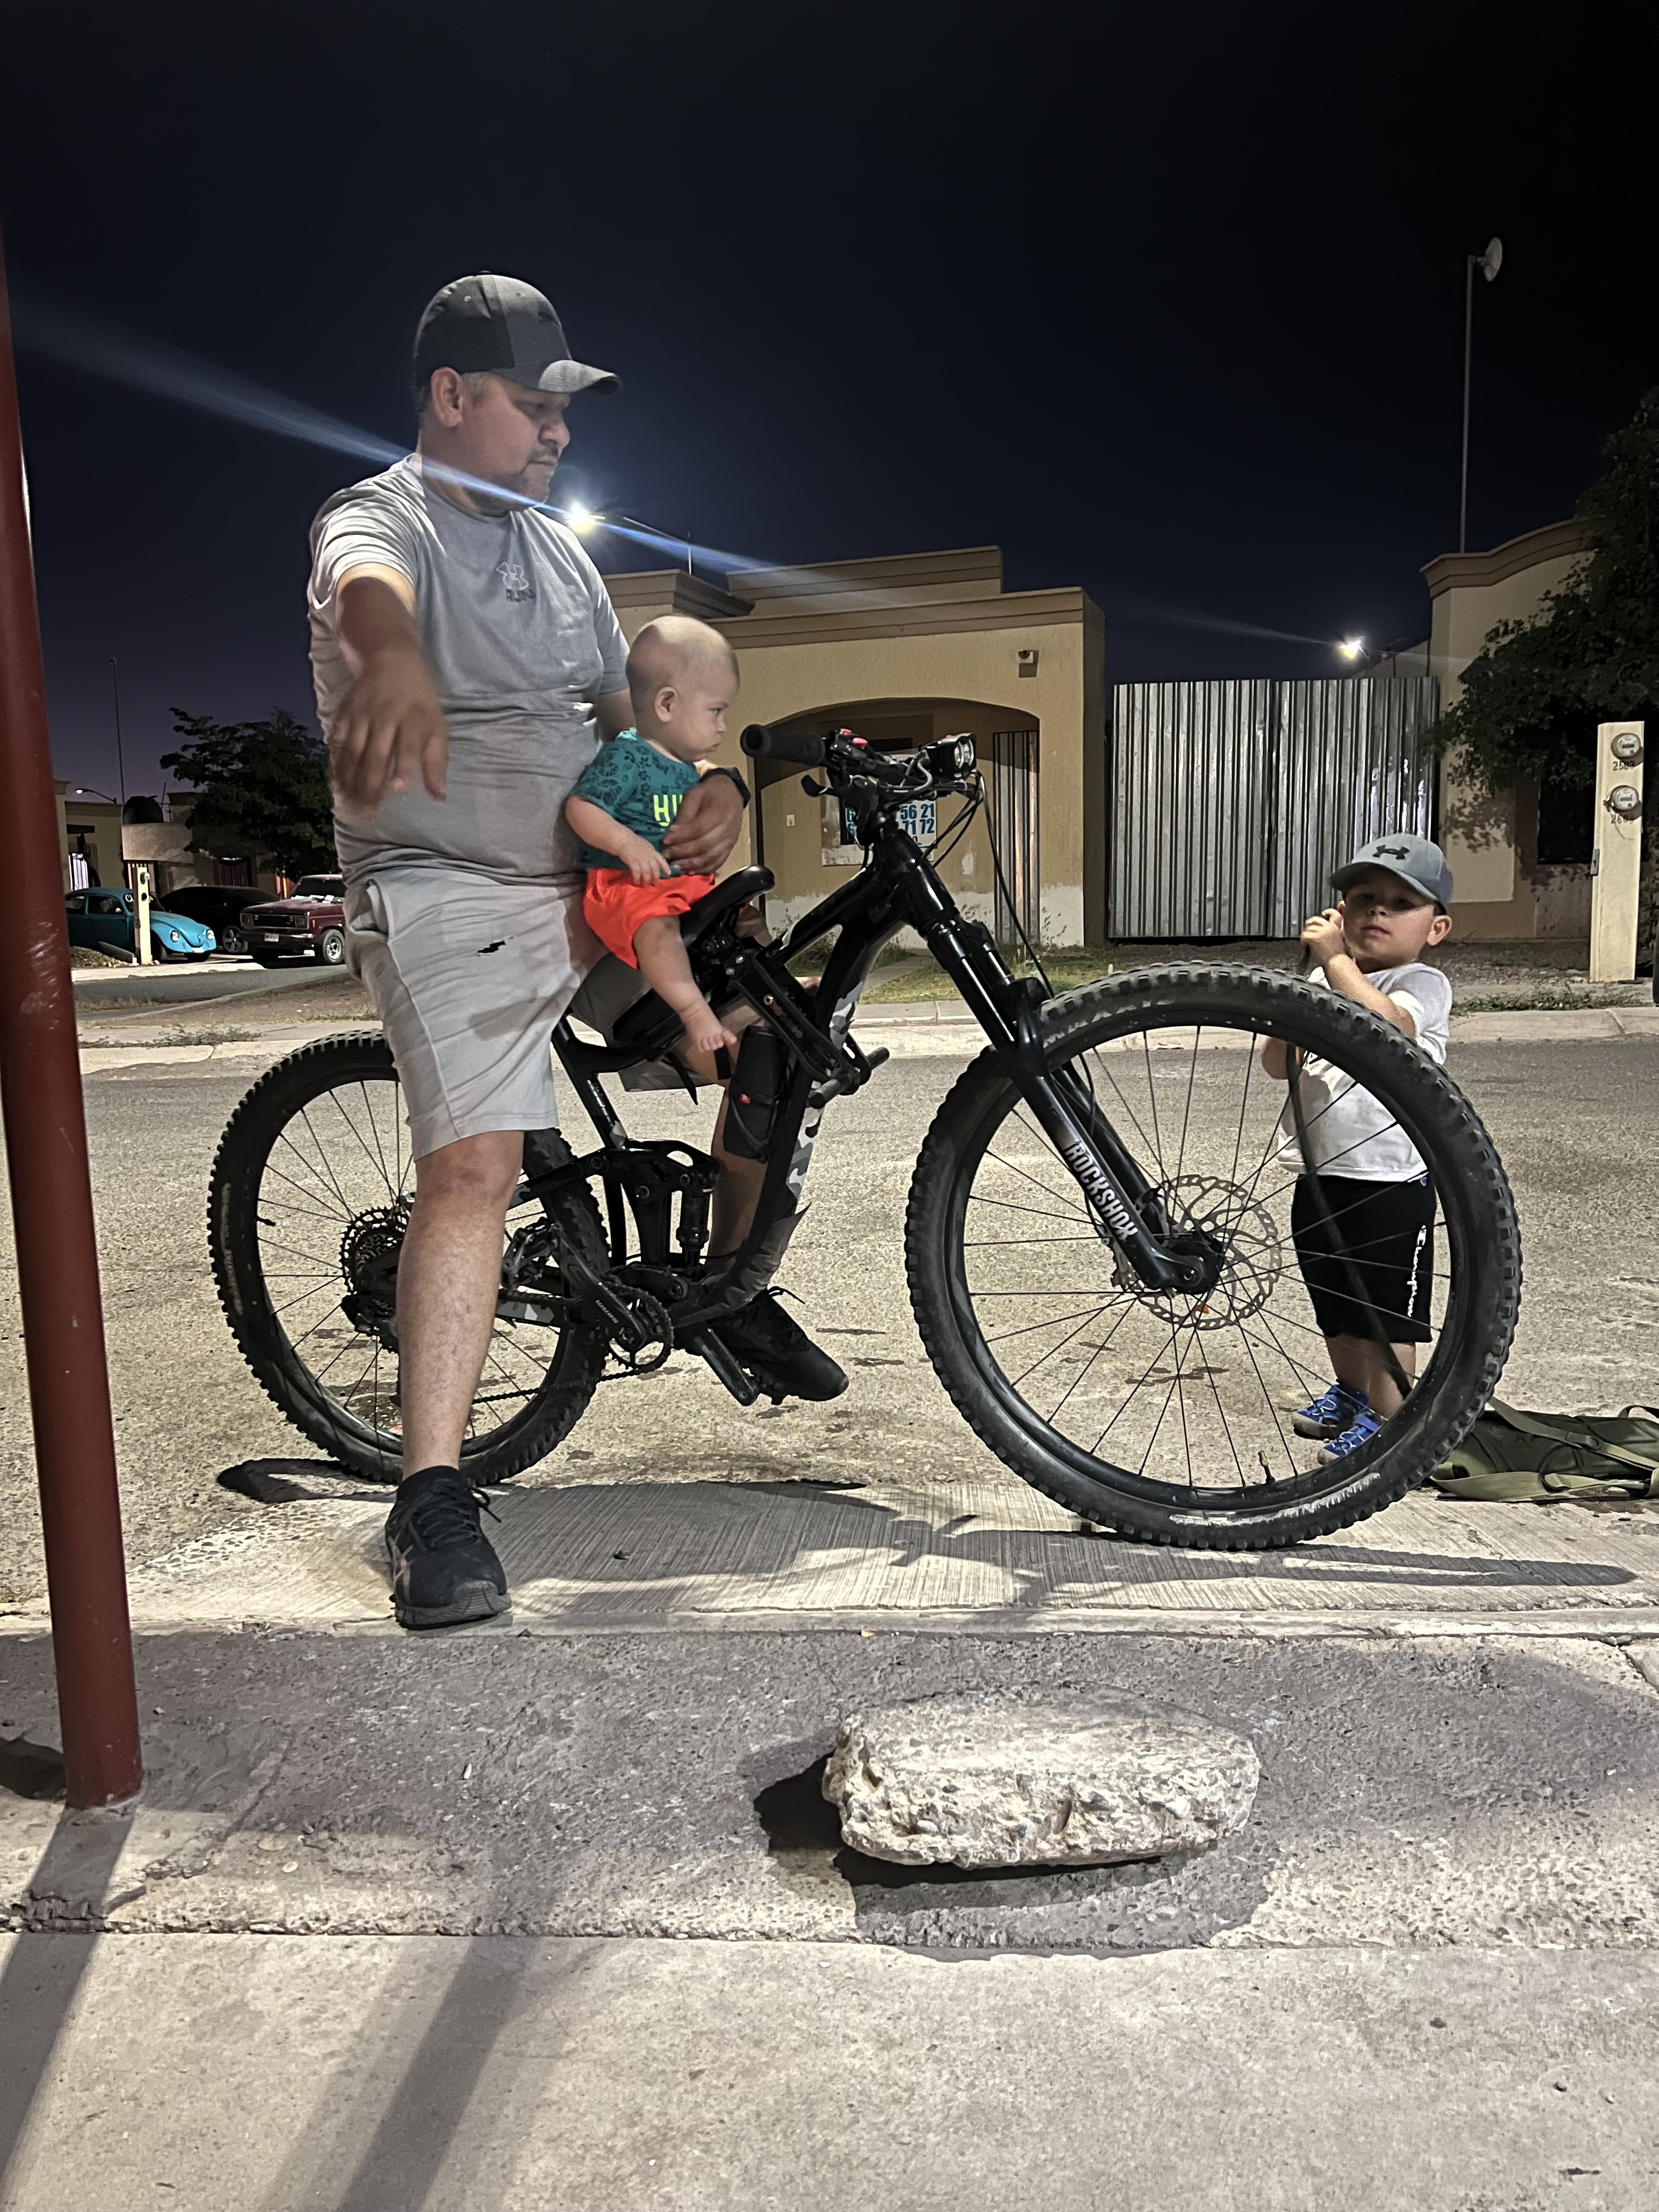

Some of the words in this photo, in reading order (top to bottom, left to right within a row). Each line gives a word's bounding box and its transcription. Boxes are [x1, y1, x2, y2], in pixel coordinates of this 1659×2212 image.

[900, 804, 917, 820] 56
[921, 803, 935, 819] 21
[902, 820, 917, 835] 71
[919, 818, 935, 834] 72
[1065, 1140, 1139, 1242] ROCKSHOX
[1407, 1224, 1427, 1318] Champion
